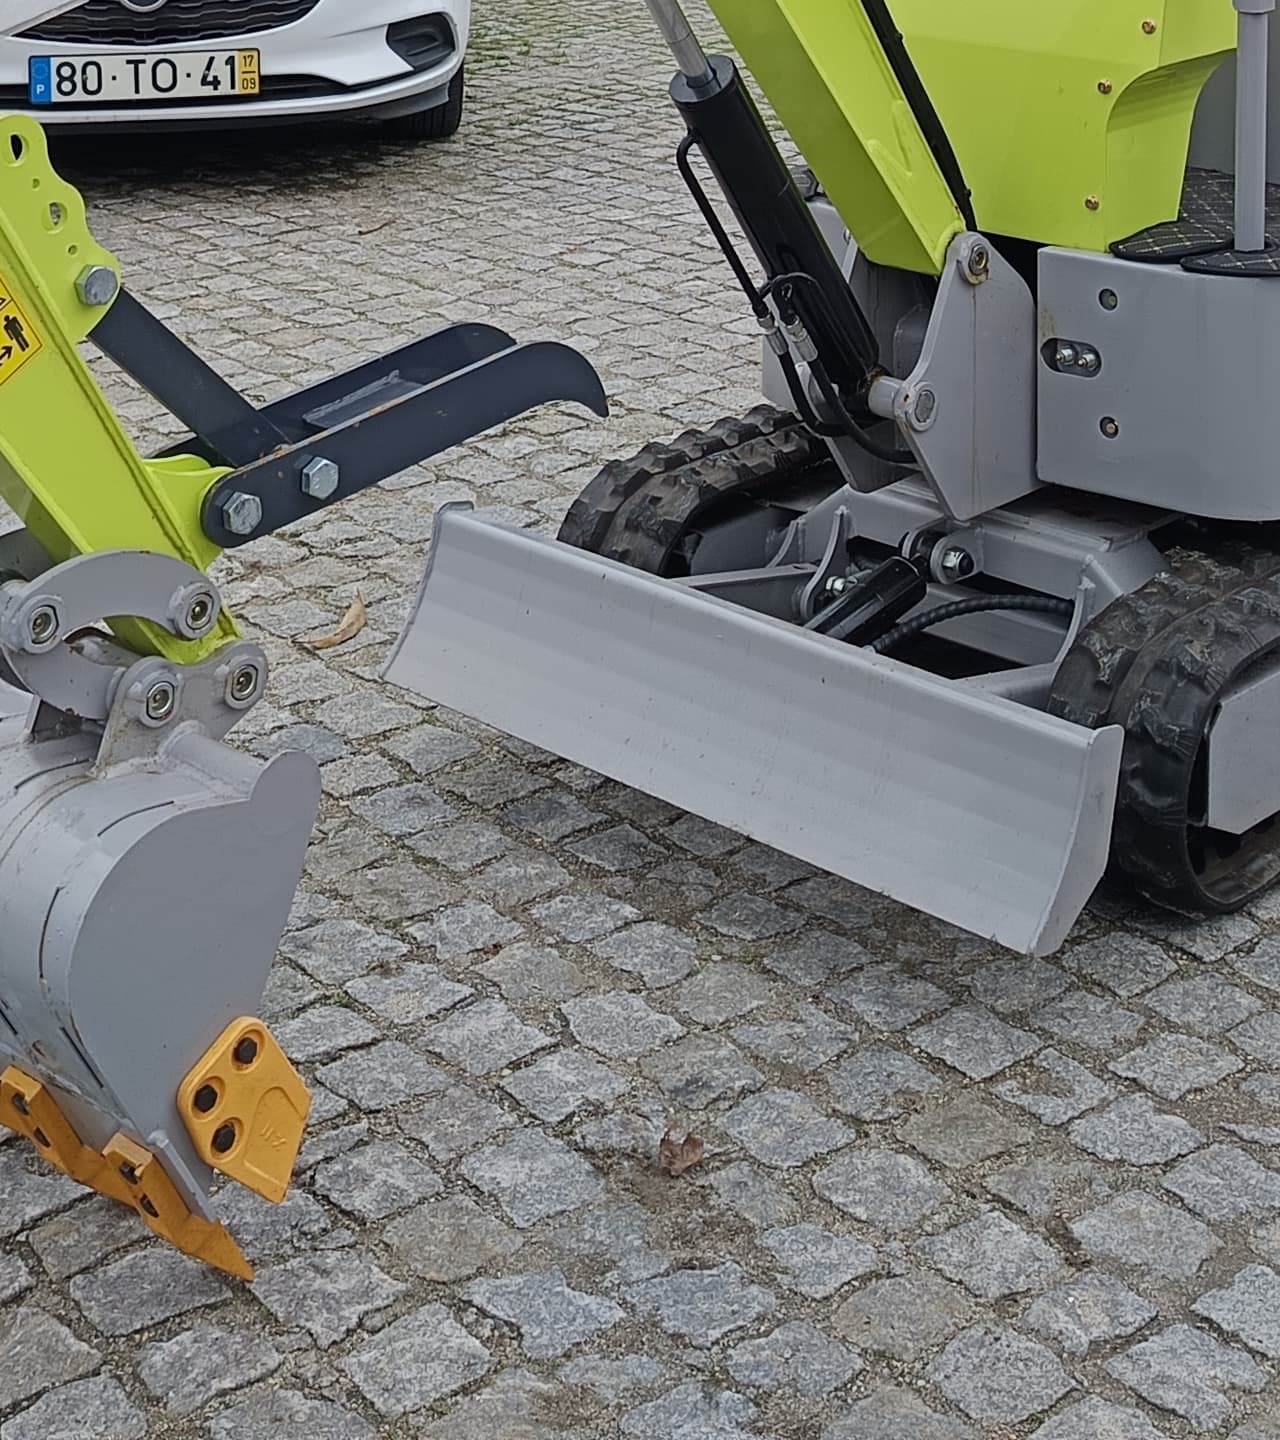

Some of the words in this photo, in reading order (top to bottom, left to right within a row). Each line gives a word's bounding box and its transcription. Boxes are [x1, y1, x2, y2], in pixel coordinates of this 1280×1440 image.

[243, 54, 254, 68] 17
[36, 84, 45, 95] P
[242, 77, 256, 90] 09
